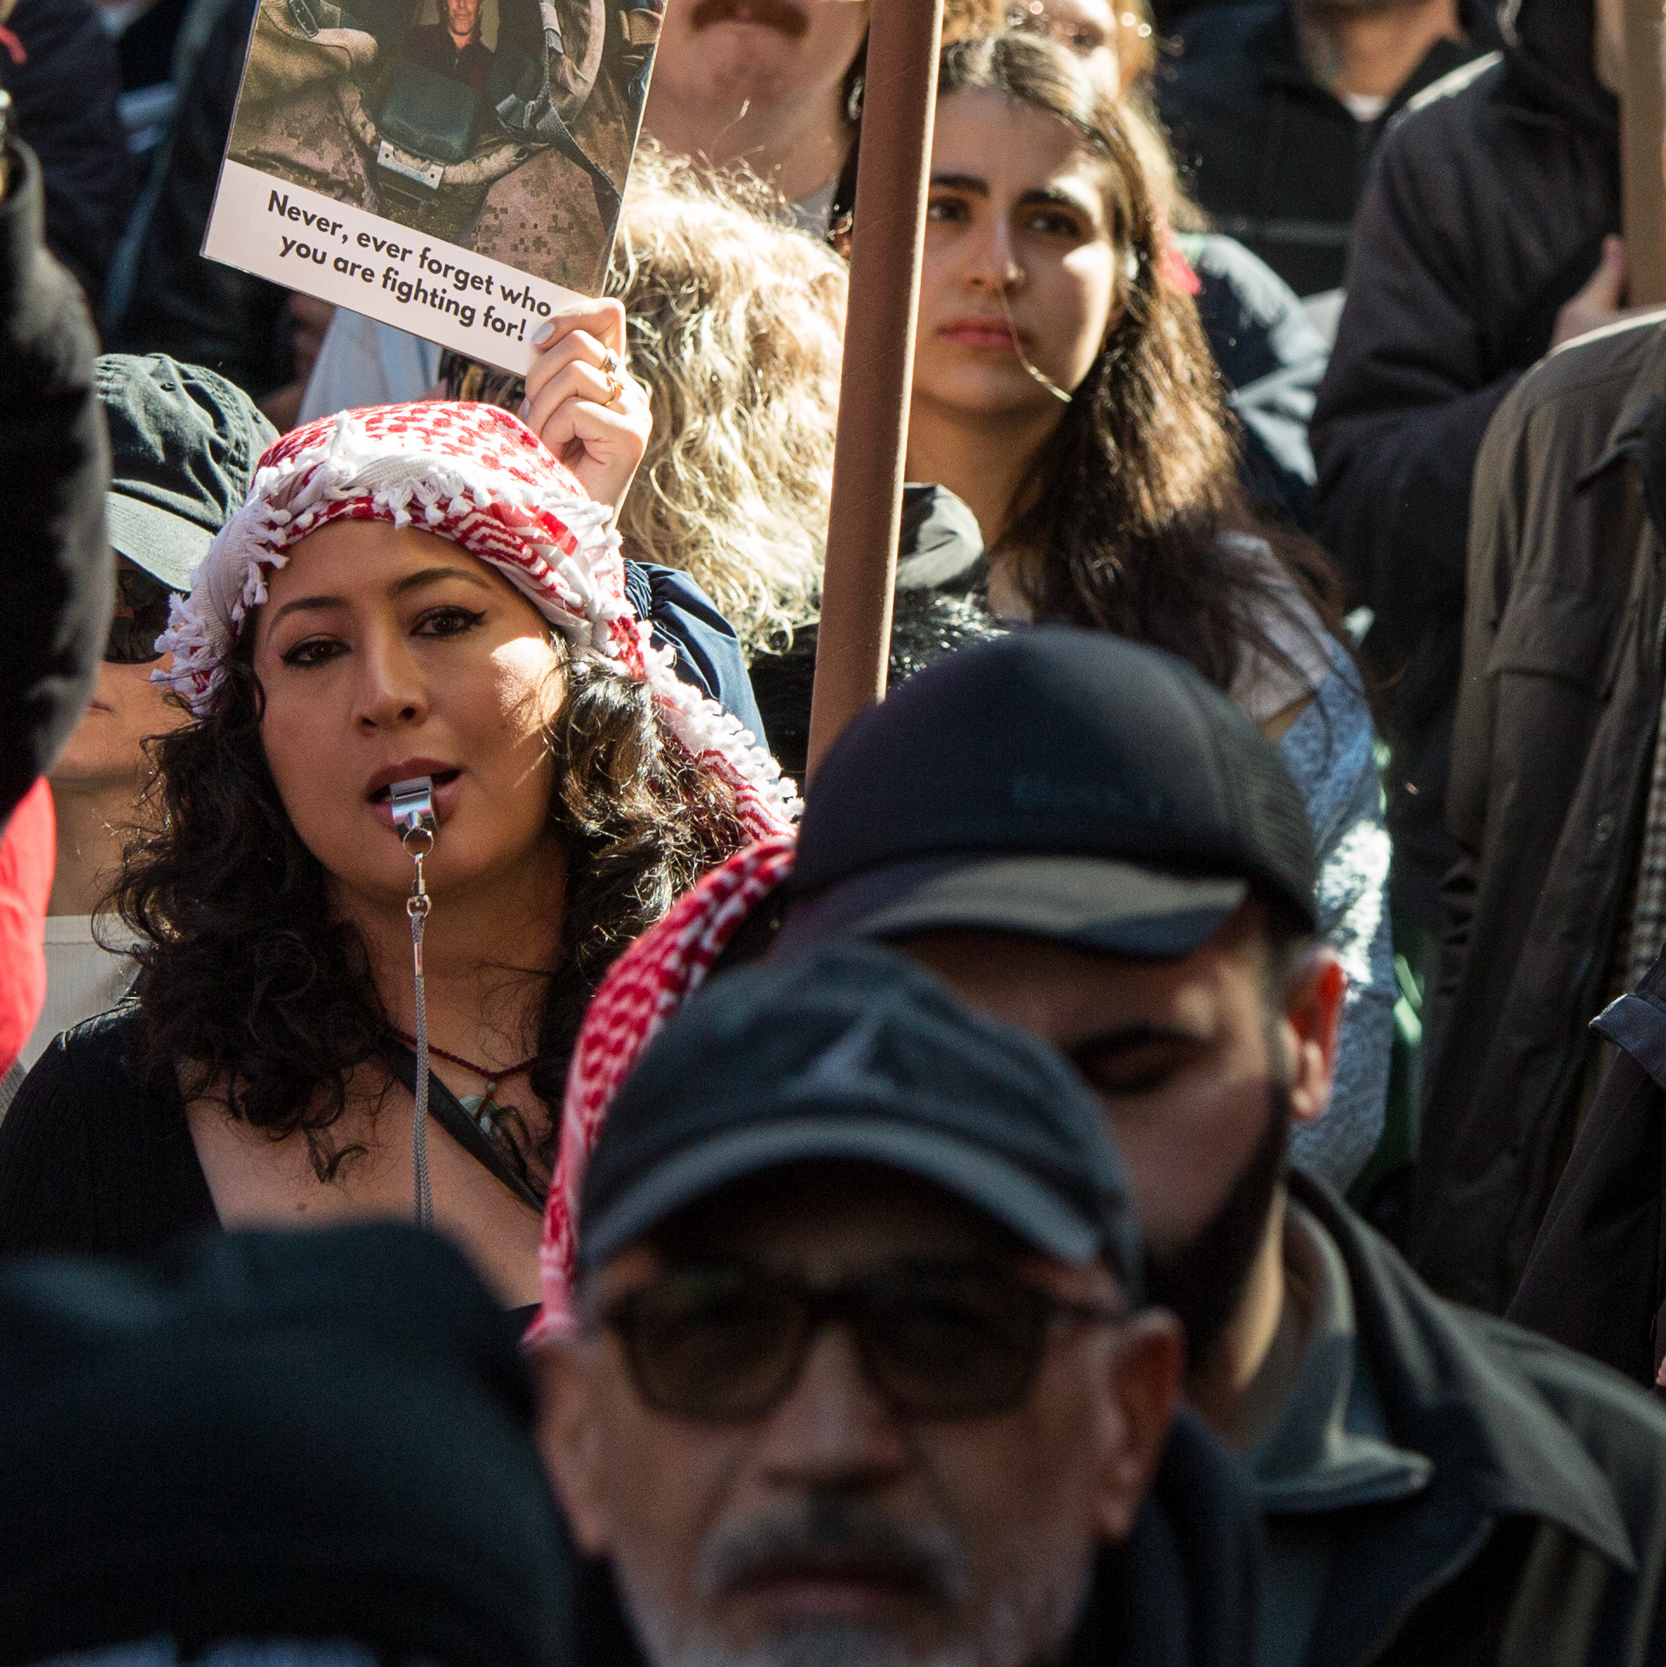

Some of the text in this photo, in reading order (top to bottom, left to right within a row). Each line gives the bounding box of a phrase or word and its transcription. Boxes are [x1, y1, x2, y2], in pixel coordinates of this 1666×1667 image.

[267, 189, 552, 318] Never, ever forget who
[278, 235, 528, 344] you are fighting for!
